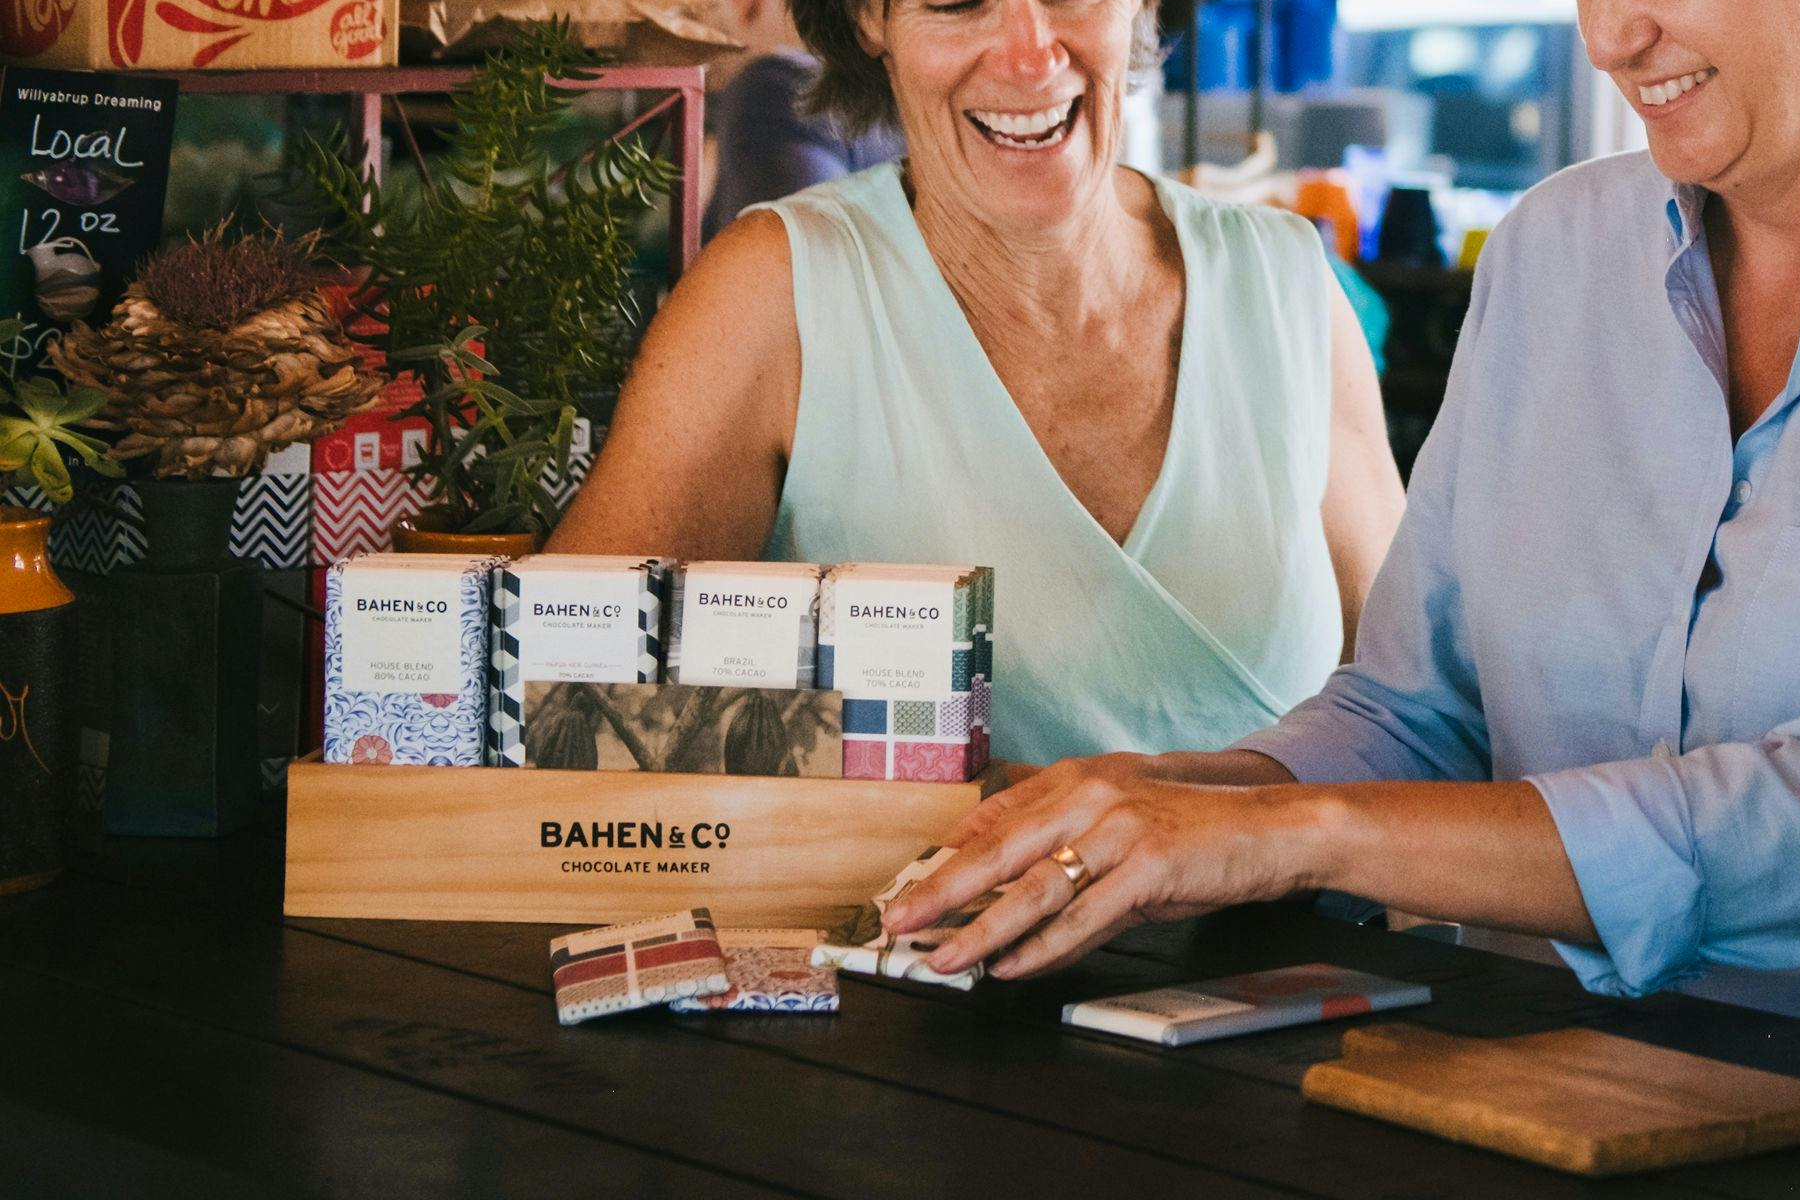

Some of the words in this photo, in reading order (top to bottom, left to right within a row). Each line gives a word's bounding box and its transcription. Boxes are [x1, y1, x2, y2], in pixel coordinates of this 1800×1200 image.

[18, 88, 89, 106] Willyabrup
[95, 93, 162, 112] Dreaming
[20, 208, 75, 255] 12
[713, 610, 748, 618] CHOCOLATE
[543, 621, 584, 629] CHOCOLATE
[370, 661, 400, 670] HOUSE
[404, 662, 434, 671] BLEND
[724, 656, 755, 666] BRAZIL
[374, 672, 395, 681] 80%
[398, 672, 430, 681] CACAO
[712, 667, 732, 676] 70%
[735, 667, 767, 678] CACAO
[862, 668, 892, 678] HOUSE
[895, 669, 925, 679] BLEND
[866, 679, 887, 688] 70%
[889, 679, 921, 689] CACAO
[561, 861, 651, 873] CHOCOLATE
[657, 861, 710, 874] MAKER
